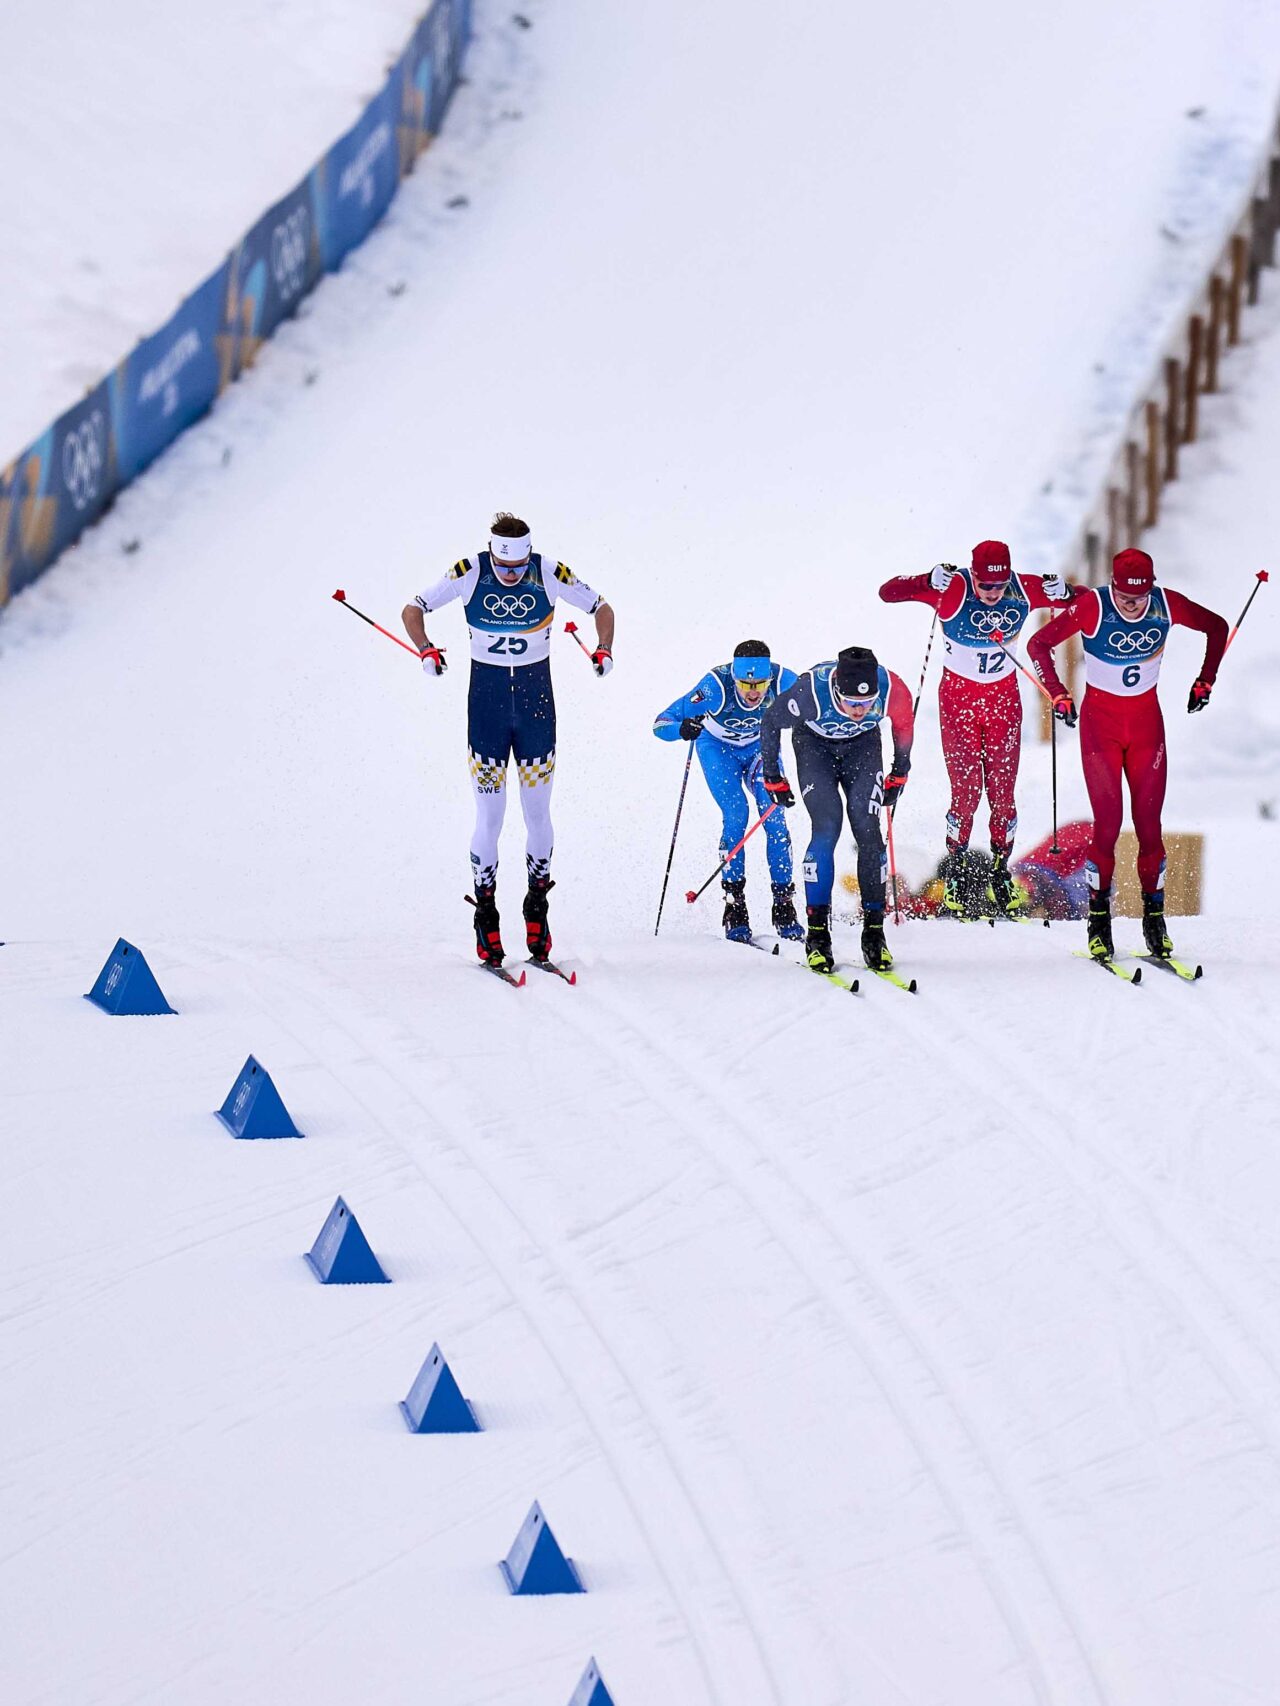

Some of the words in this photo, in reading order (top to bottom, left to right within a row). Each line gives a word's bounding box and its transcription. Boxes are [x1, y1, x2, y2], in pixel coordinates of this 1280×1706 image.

[487, 635, 528, 655] 25
[977, 651, 1006, 674] 12
[1122, 665, 1141, 687] 6
[477, 785, 500, 793] SWE
